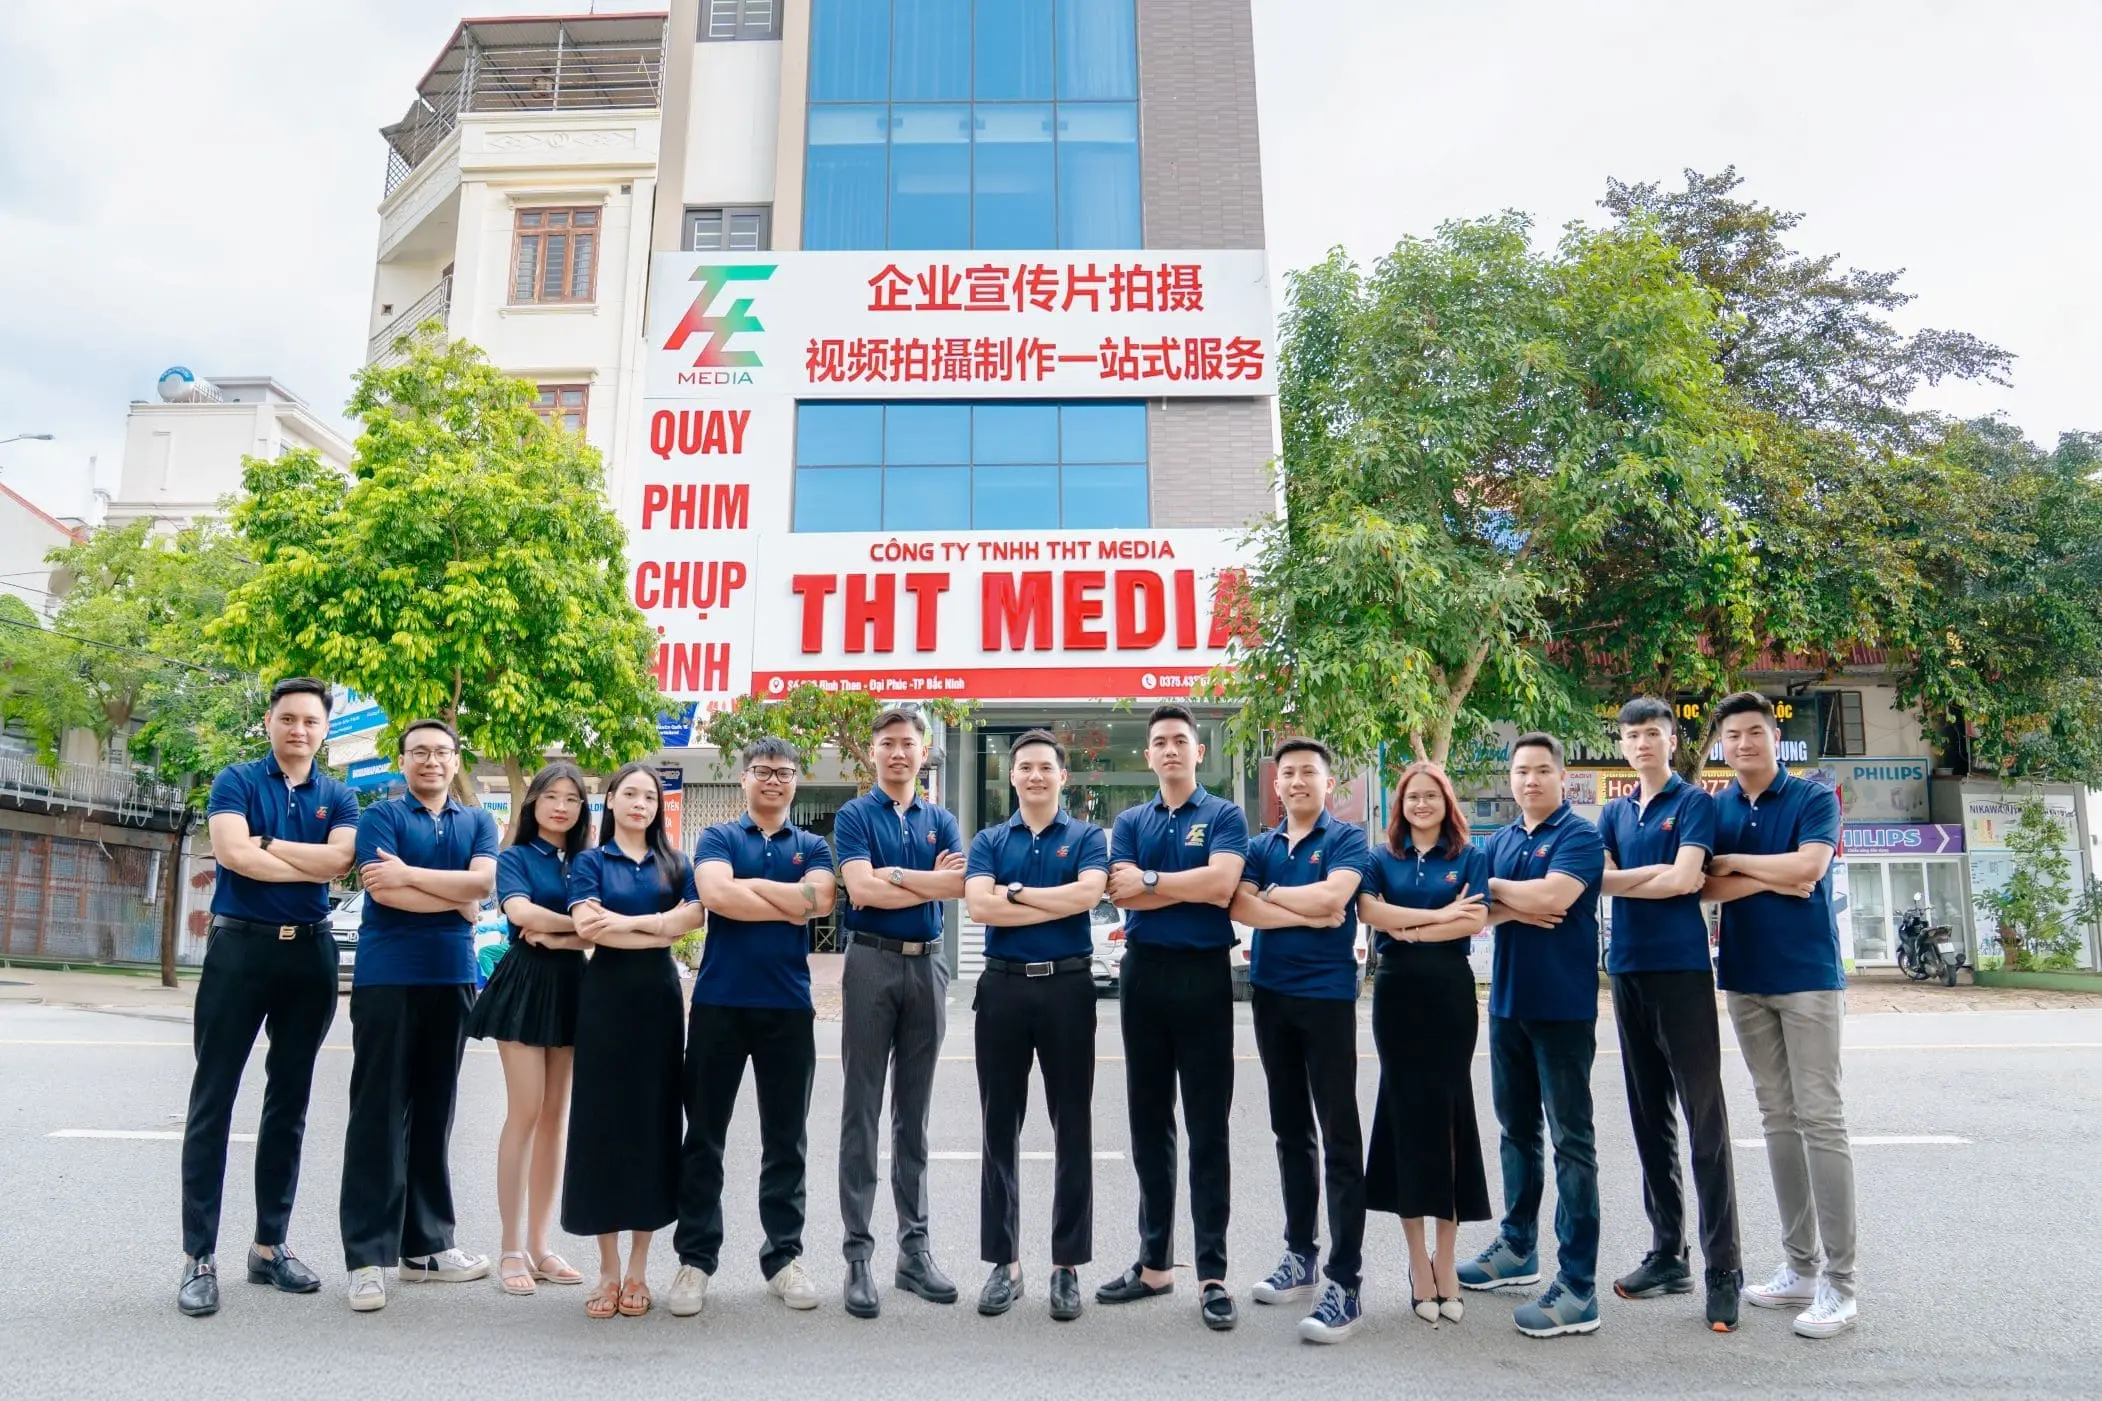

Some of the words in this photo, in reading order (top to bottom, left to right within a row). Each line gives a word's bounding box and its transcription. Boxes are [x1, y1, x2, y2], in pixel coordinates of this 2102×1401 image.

[868, 263, 1204, 312] 企业宣传片拍摄
[678, 371, 754, 384] MEDIA
[651, 410, 751, 460] QUAY
[642, 484, 749, 529] PHIM
[870, 538, 934, 561] CÔNG
[941, 543, 971, 561] TY
[978, 542, 1039, 561] TNHH
[1047, 541, 1091, 560] THT
[1099, 540, 1175, 560] MEDIA
[635, 561, 746, 620] CHỤP
[793, 573, 950, 653] THT
[982, 568, 1264, 651] MEDIA
[945, 678, 965, 690] Ninh
[1853, 766, 1923, 780] PHILIPS
